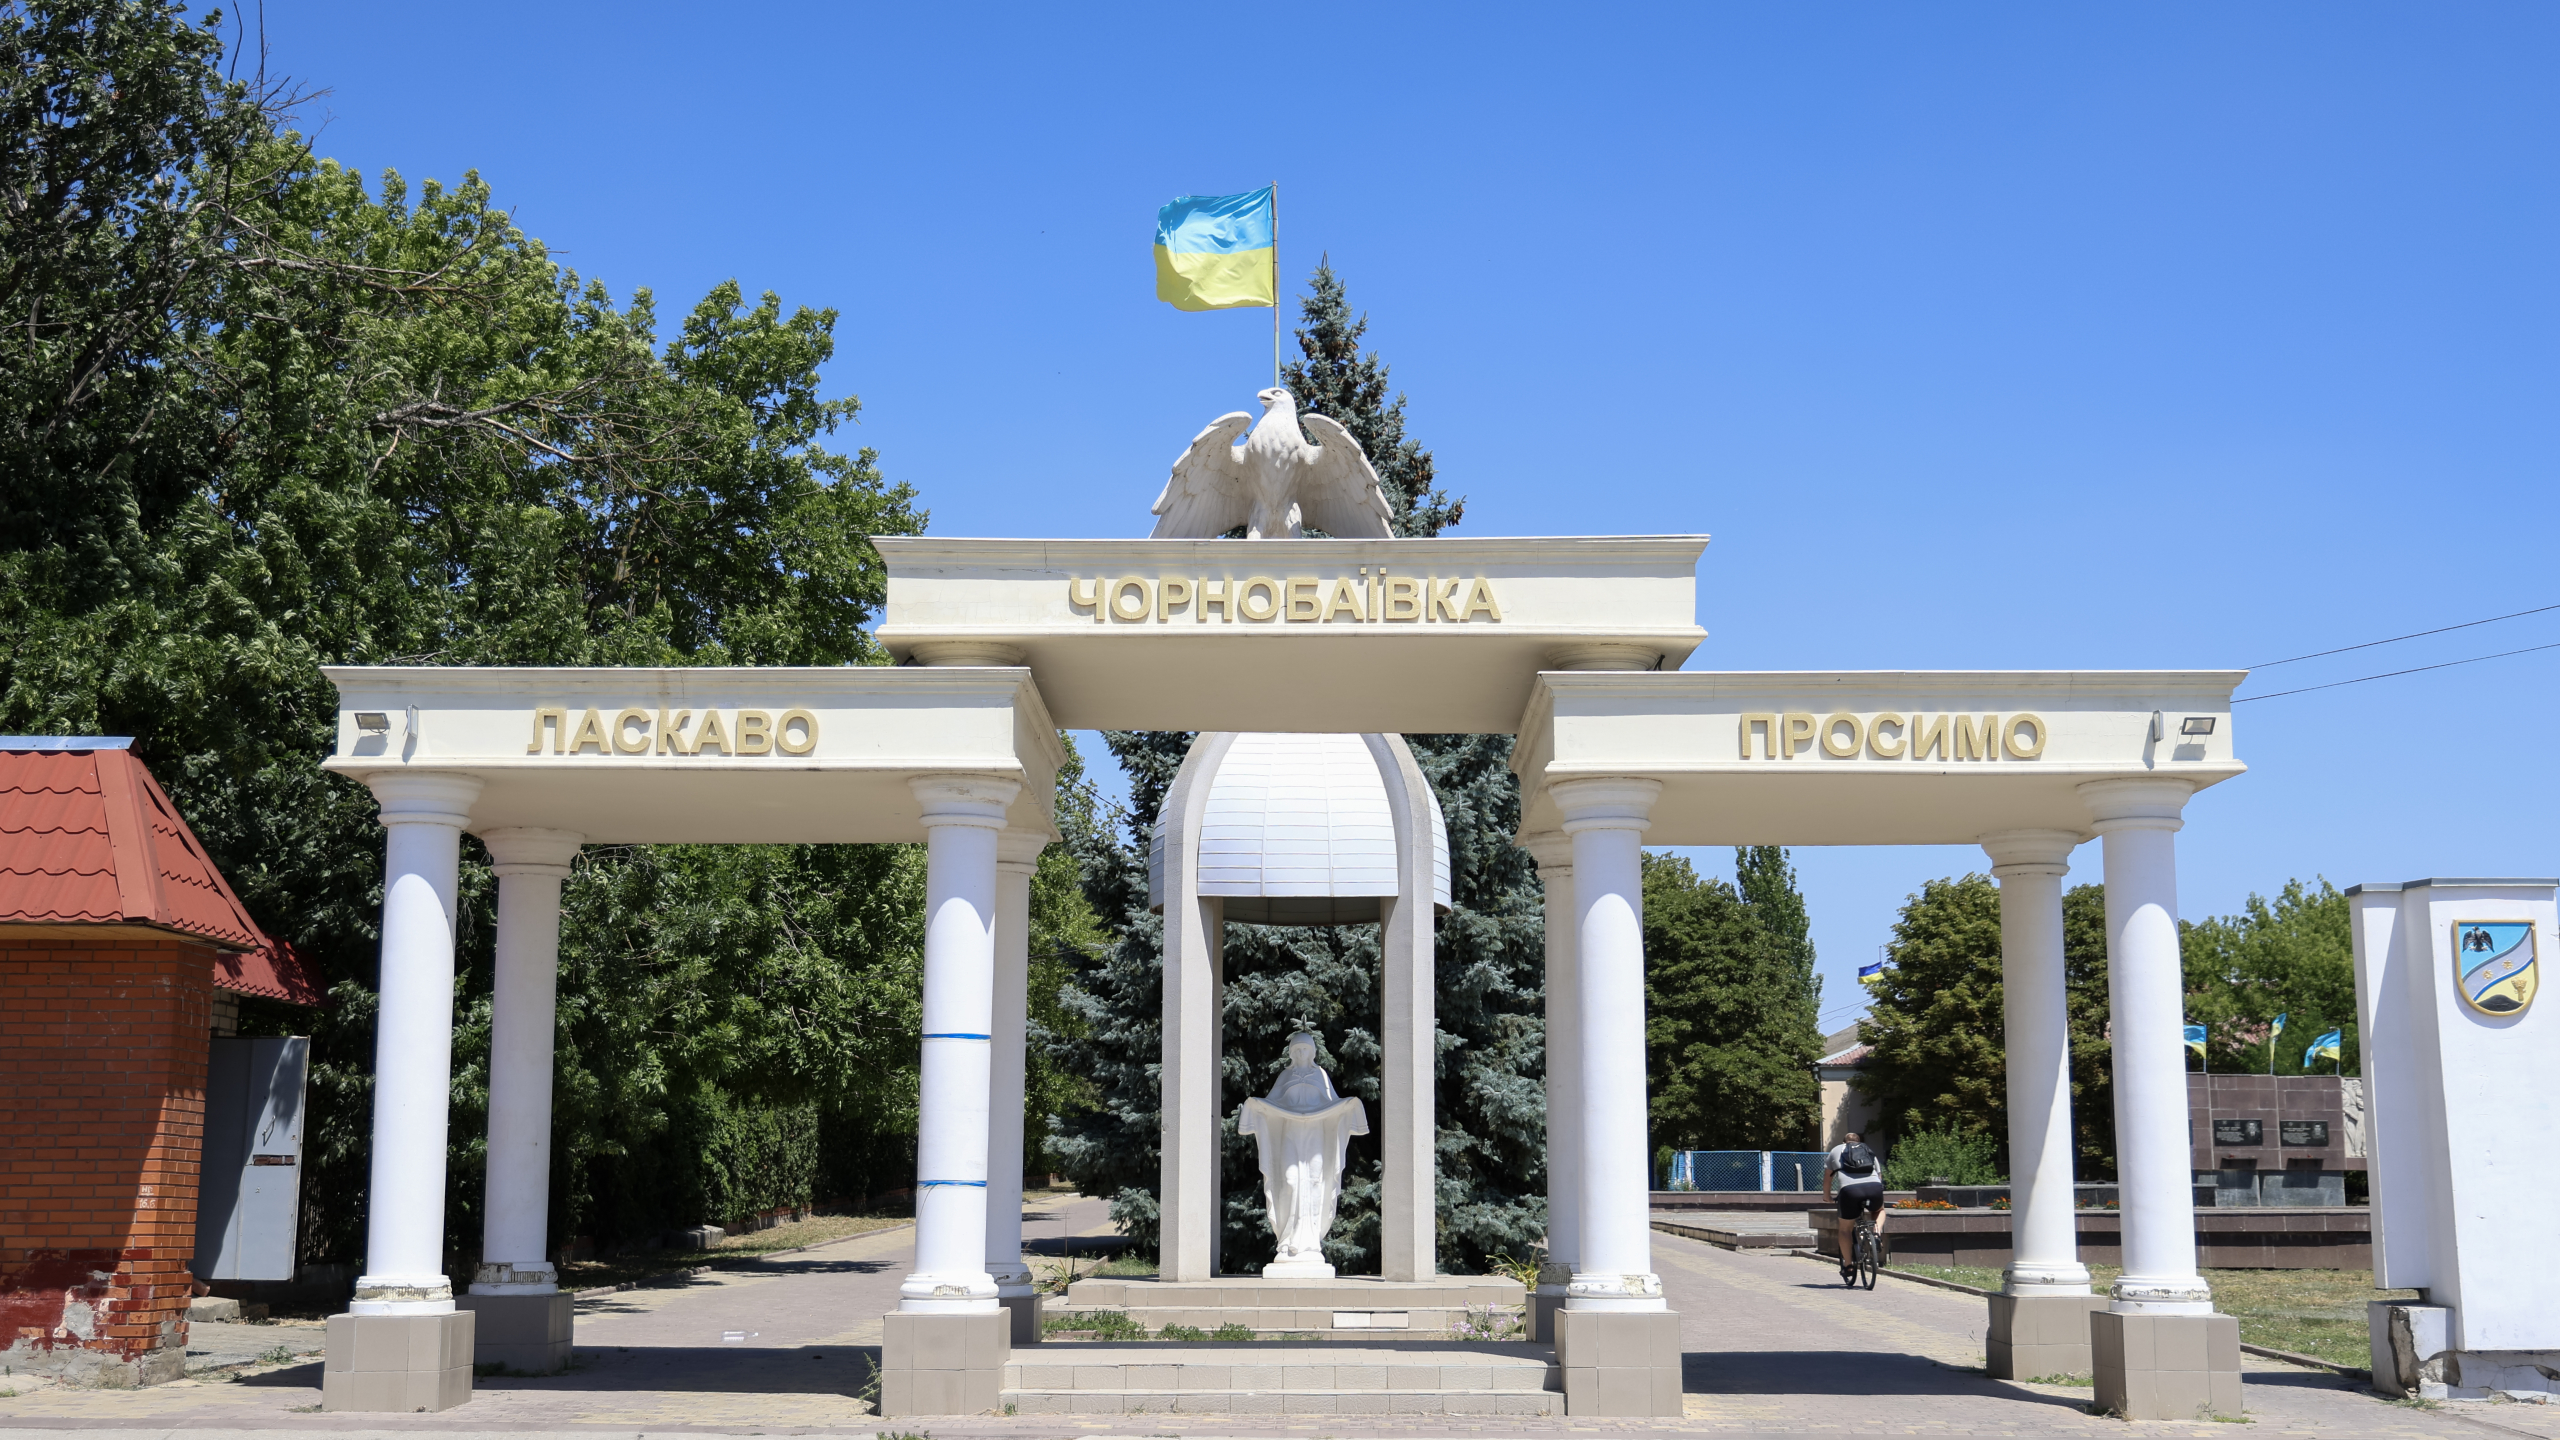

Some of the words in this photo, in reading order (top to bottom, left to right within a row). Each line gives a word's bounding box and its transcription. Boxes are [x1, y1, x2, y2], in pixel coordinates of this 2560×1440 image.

[1070, 567, 1502, 621] ЧОРНОБАЇВКА
[527, 707, 819, 754] ЛАСКАВО
[1741, 713, 2047, 759] ПРОСИМО
